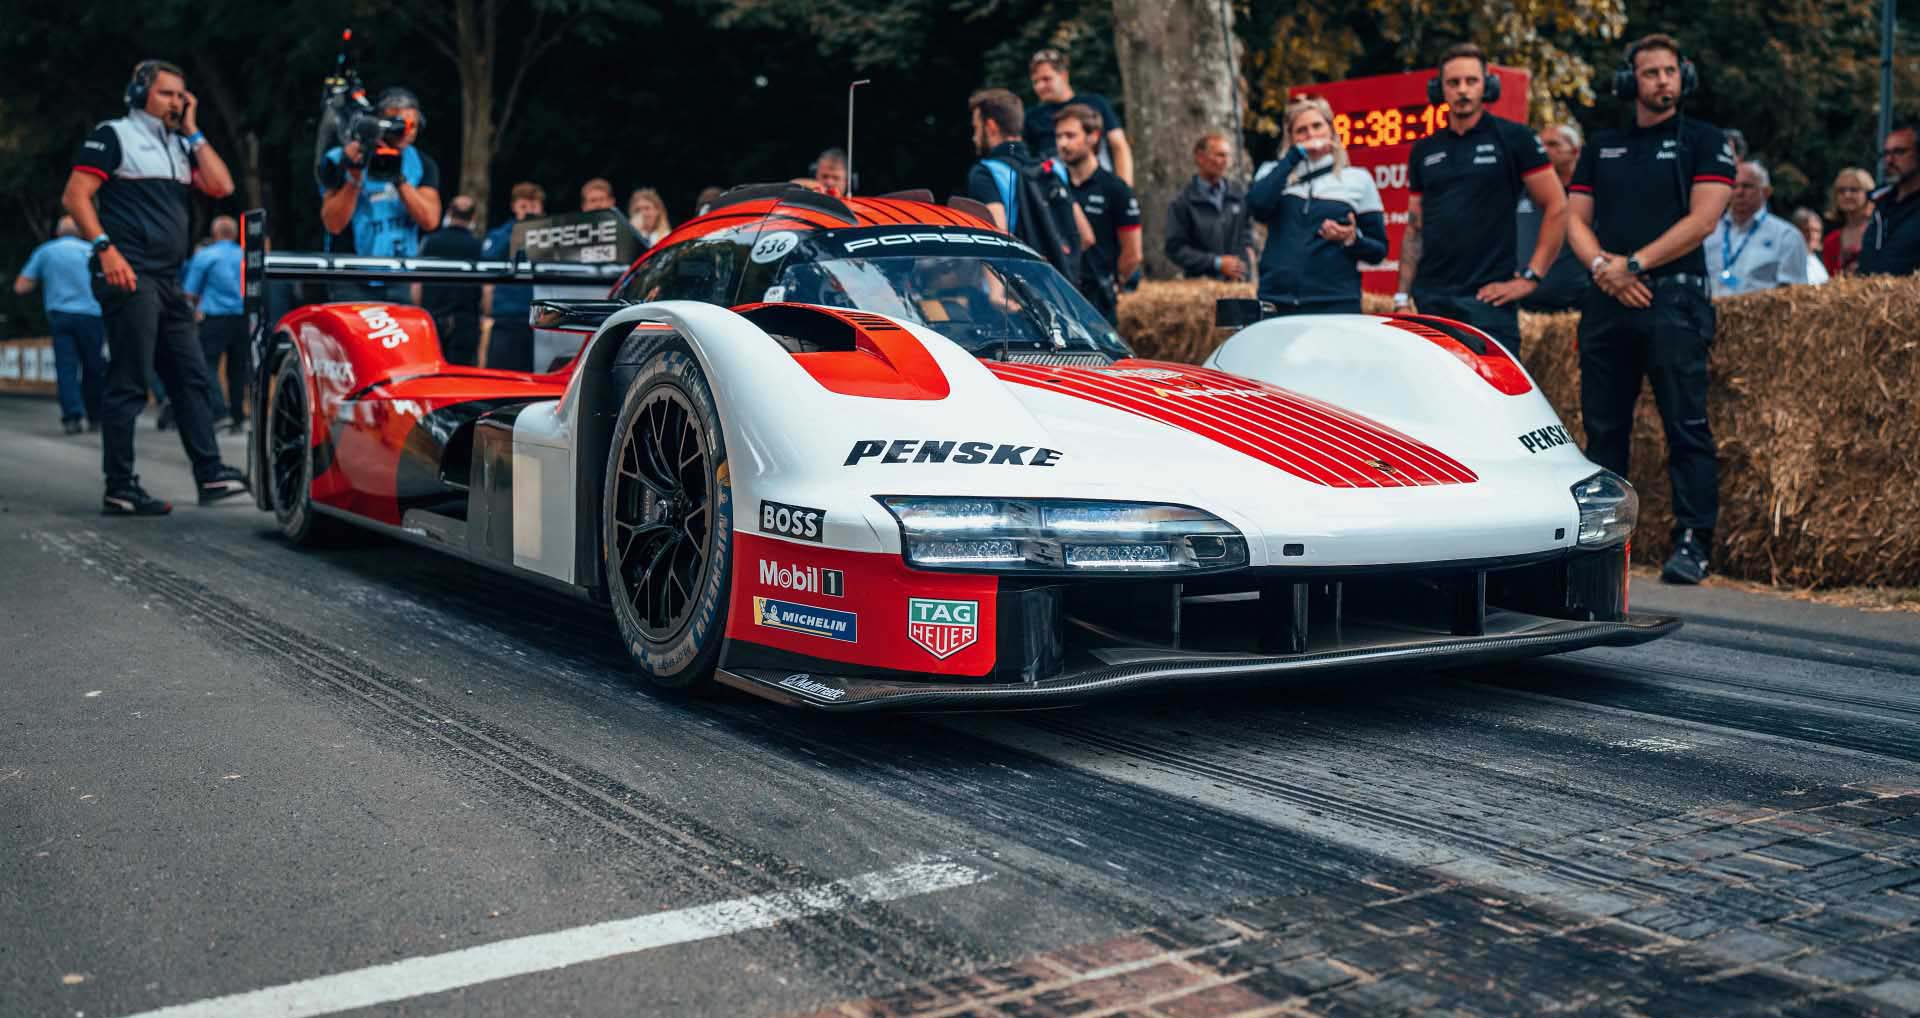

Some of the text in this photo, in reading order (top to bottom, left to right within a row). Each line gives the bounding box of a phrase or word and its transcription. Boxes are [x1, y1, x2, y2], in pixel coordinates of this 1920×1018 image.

[1375, 164, 1411, 190] DU
[525, 221, 617, 248] PORSCHE
[757, 239, 788, 254] 536
[842, 439, 1064, 467] PENSKE
[763, 504, 818, 539] BOSS
[759, 559, 818, 593] Mobil
[782, 610, 848, 633] MICHELIN
[915, 603, 971, 623] TAG
[913, 625, 972, 654] HEUER
